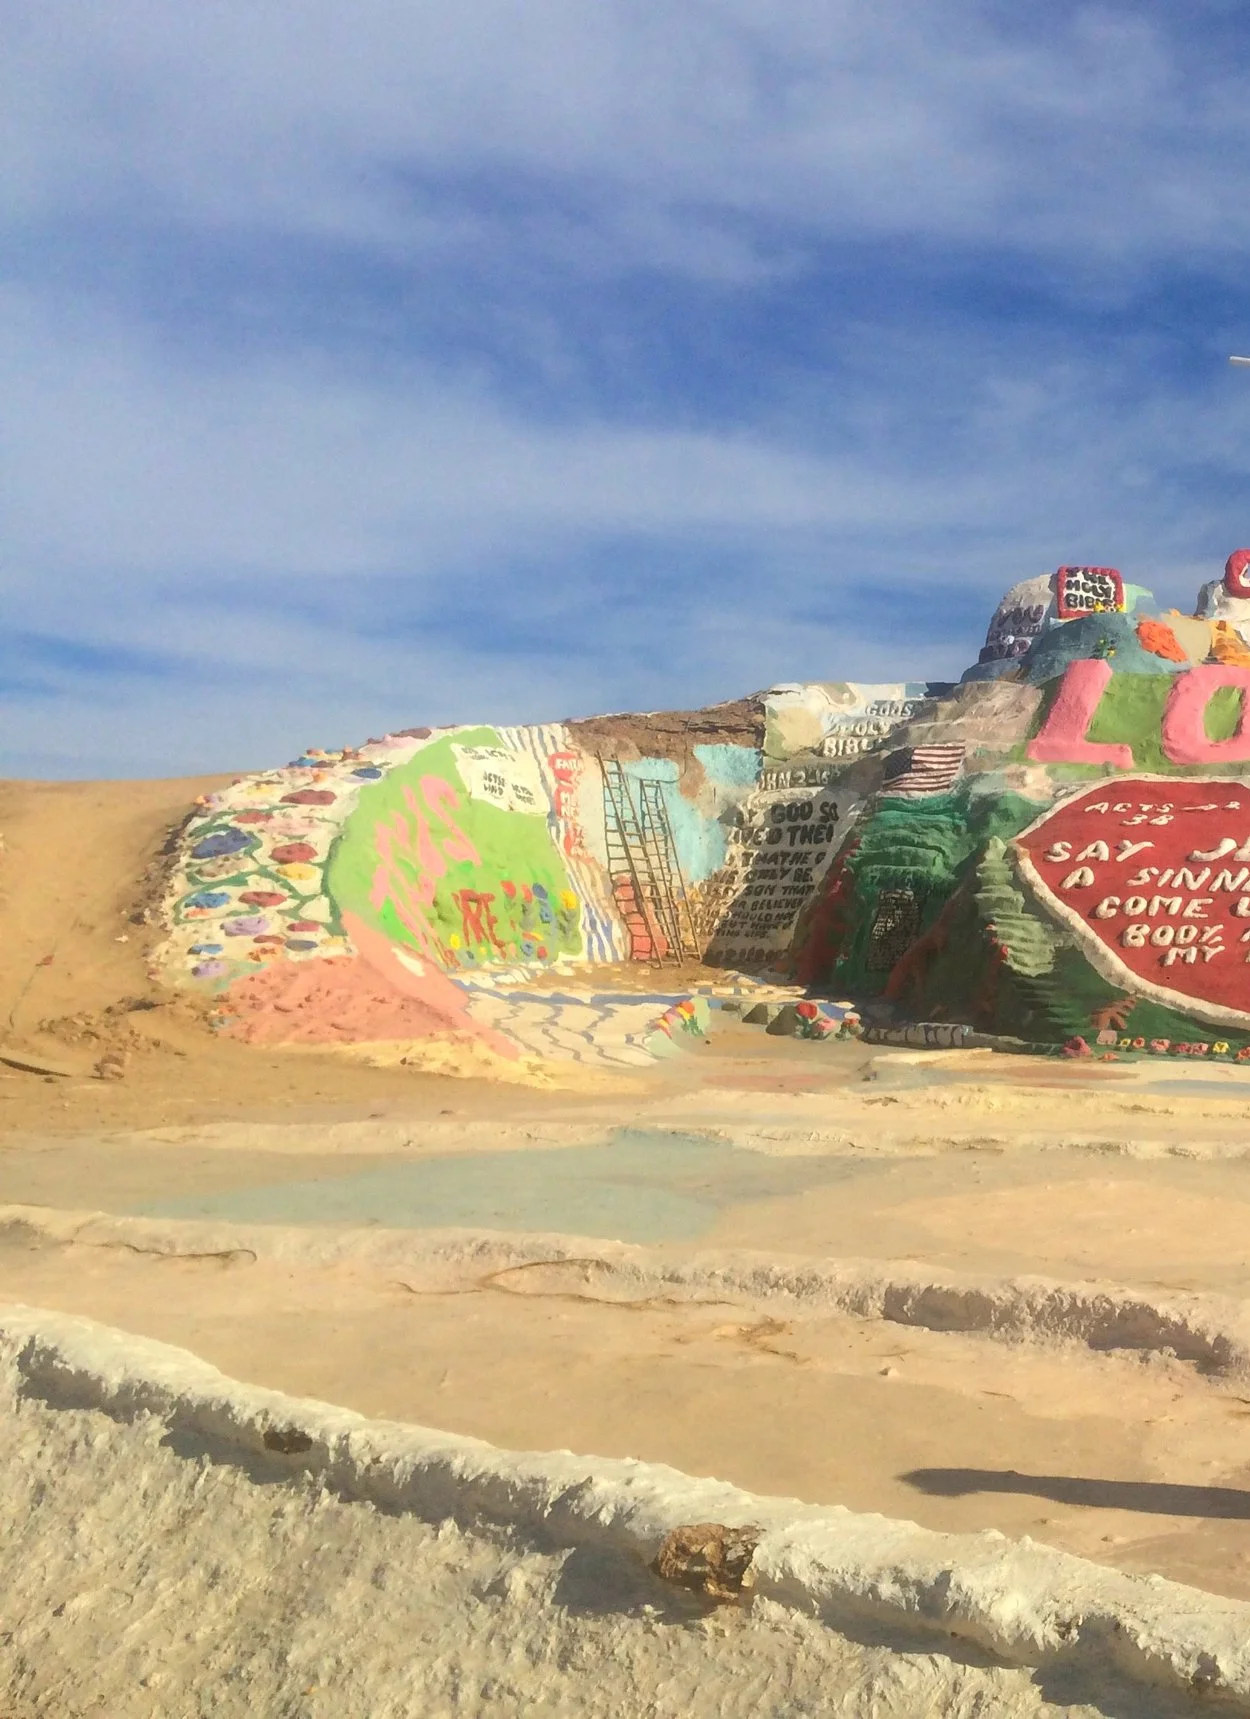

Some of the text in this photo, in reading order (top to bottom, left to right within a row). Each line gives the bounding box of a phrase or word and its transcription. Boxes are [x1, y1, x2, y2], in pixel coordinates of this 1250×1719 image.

[1044, 839, 1156, 863] SAY
[1060, 866, 1096, 890] A
[1095, 895, 1214, 920] COME
[1162, 945, 1226, 968] MY
